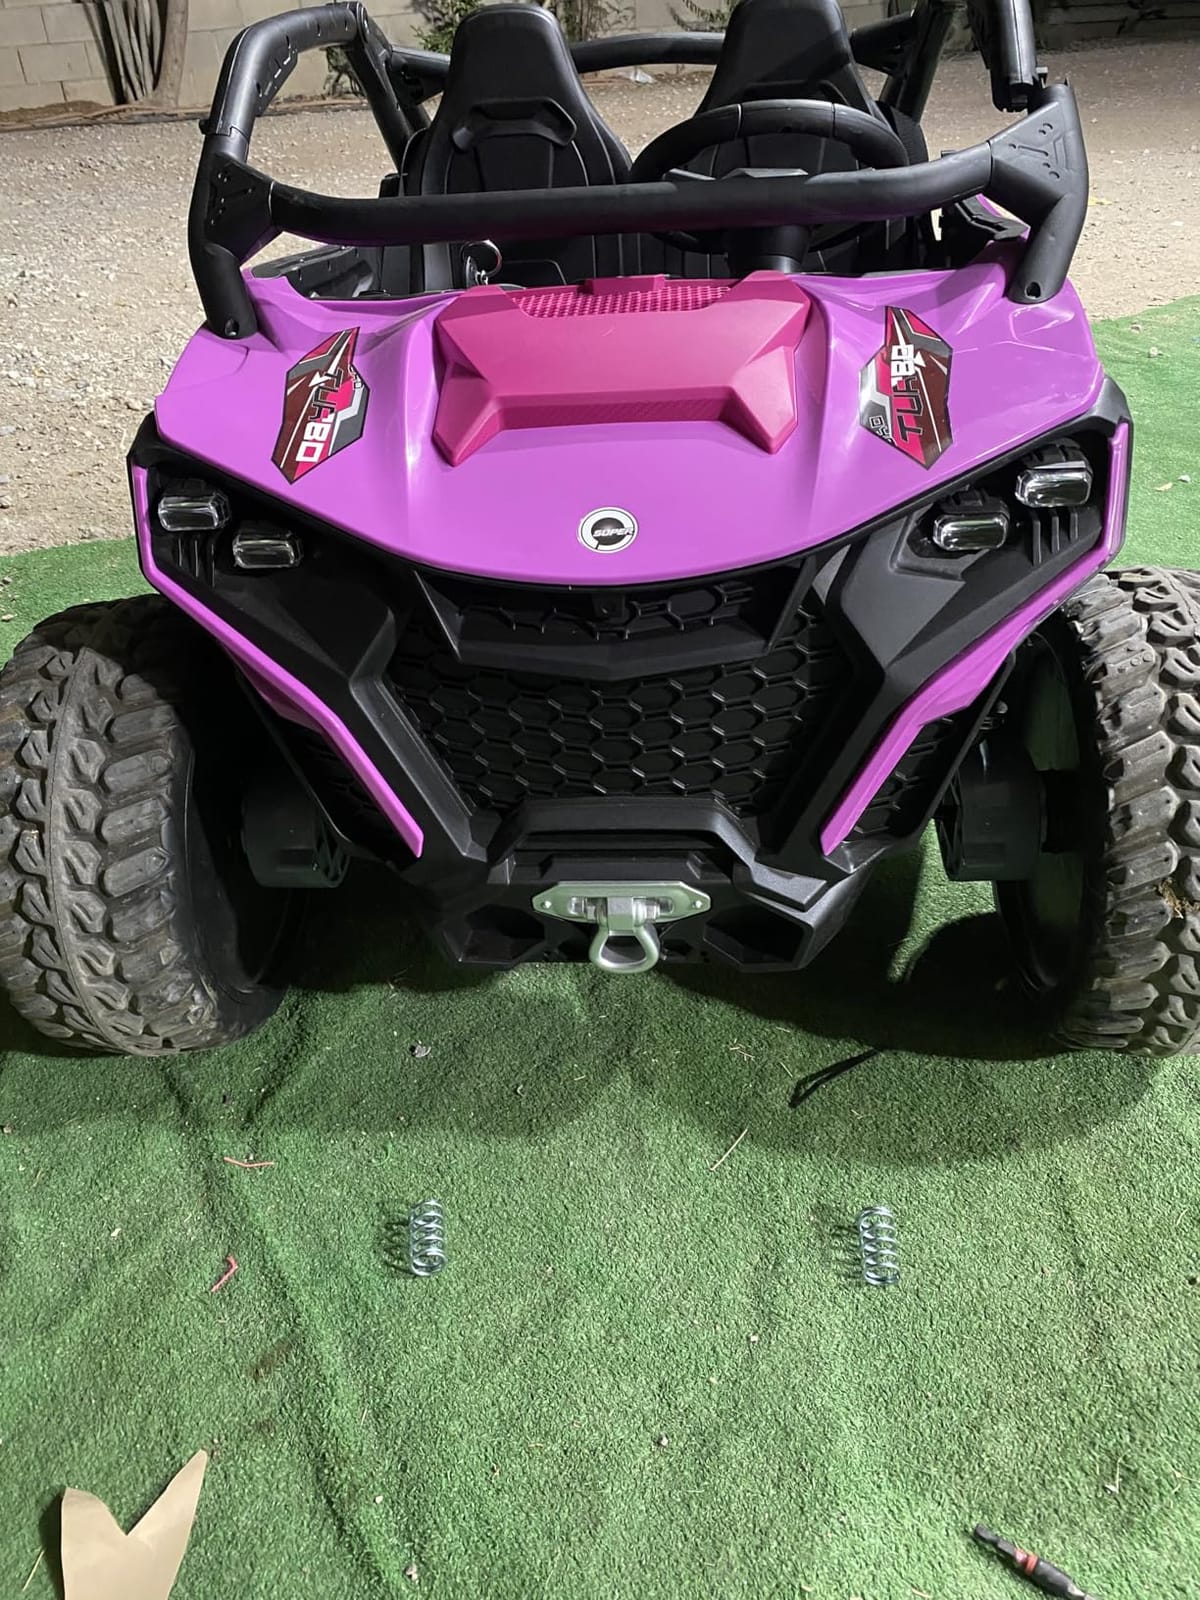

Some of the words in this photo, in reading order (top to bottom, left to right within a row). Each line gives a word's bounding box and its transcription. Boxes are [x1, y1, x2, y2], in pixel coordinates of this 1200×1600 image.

[295, 367, 344, 463] TURBO
[890, 344, 923, 443] TURBO
[592, 527, 634, 537] SUPER
